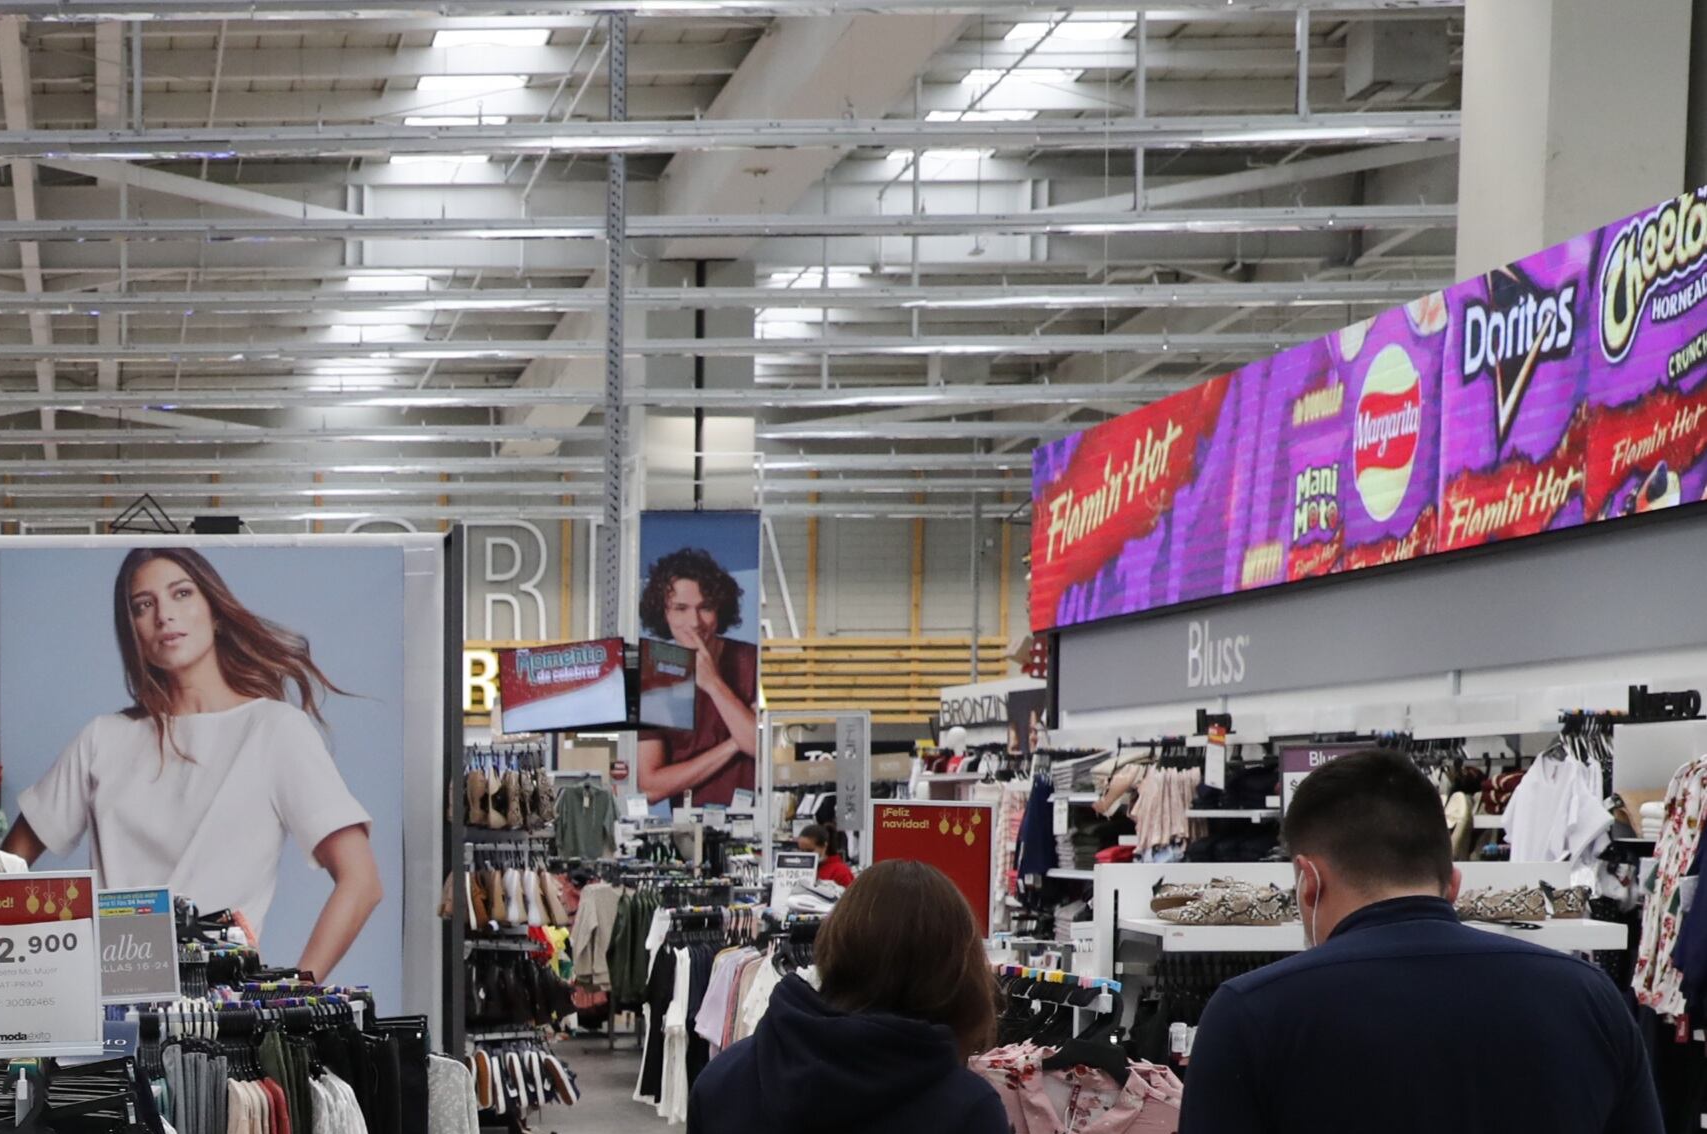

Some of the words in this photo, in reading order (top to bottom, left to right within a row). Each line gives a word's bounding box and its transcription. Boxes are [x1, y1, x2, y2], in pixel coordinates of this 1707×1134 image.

[1463, 286, 1575, 374] Doritos
[1355, 402, 1421, 459] Margarita
[1670, 404, 1707, 439] Hot
[1126, 417, 1184, 504] Hot
[1528, 464, 1583, 515] Hot
[1187, 621, 1246, 688] Bluss
[882, 807, 910, 819] ¡Feliz
[882, 818, 930, 829] navidad!
[102, 934, 154, 962] alba
